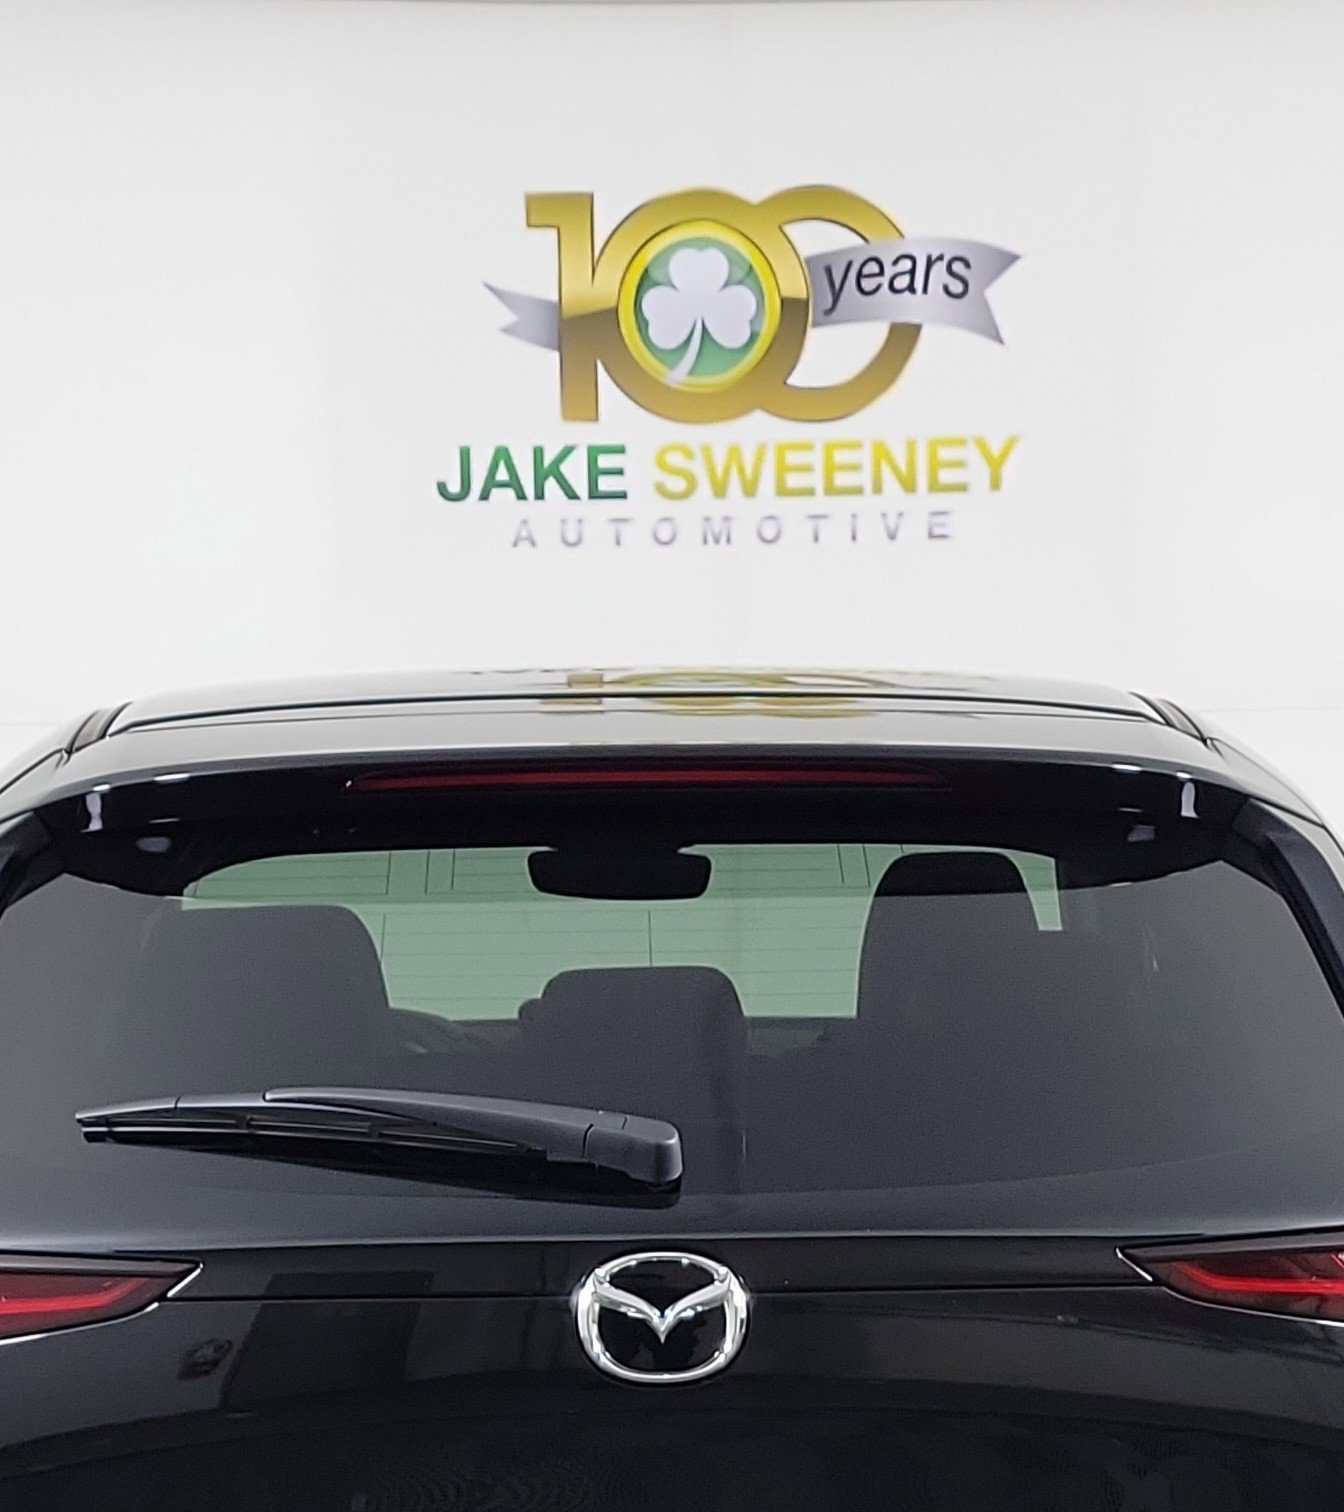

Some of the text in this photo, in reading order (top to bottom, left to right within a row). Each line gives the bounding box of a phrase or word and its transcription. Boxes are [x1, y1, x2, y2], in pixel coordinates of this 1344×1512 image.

[822, 250, 972, 316] years
[436, 435, 1021, 502] JAKE SWEENEY
[512, 510, 955, 548] AUTOMOTIVE
